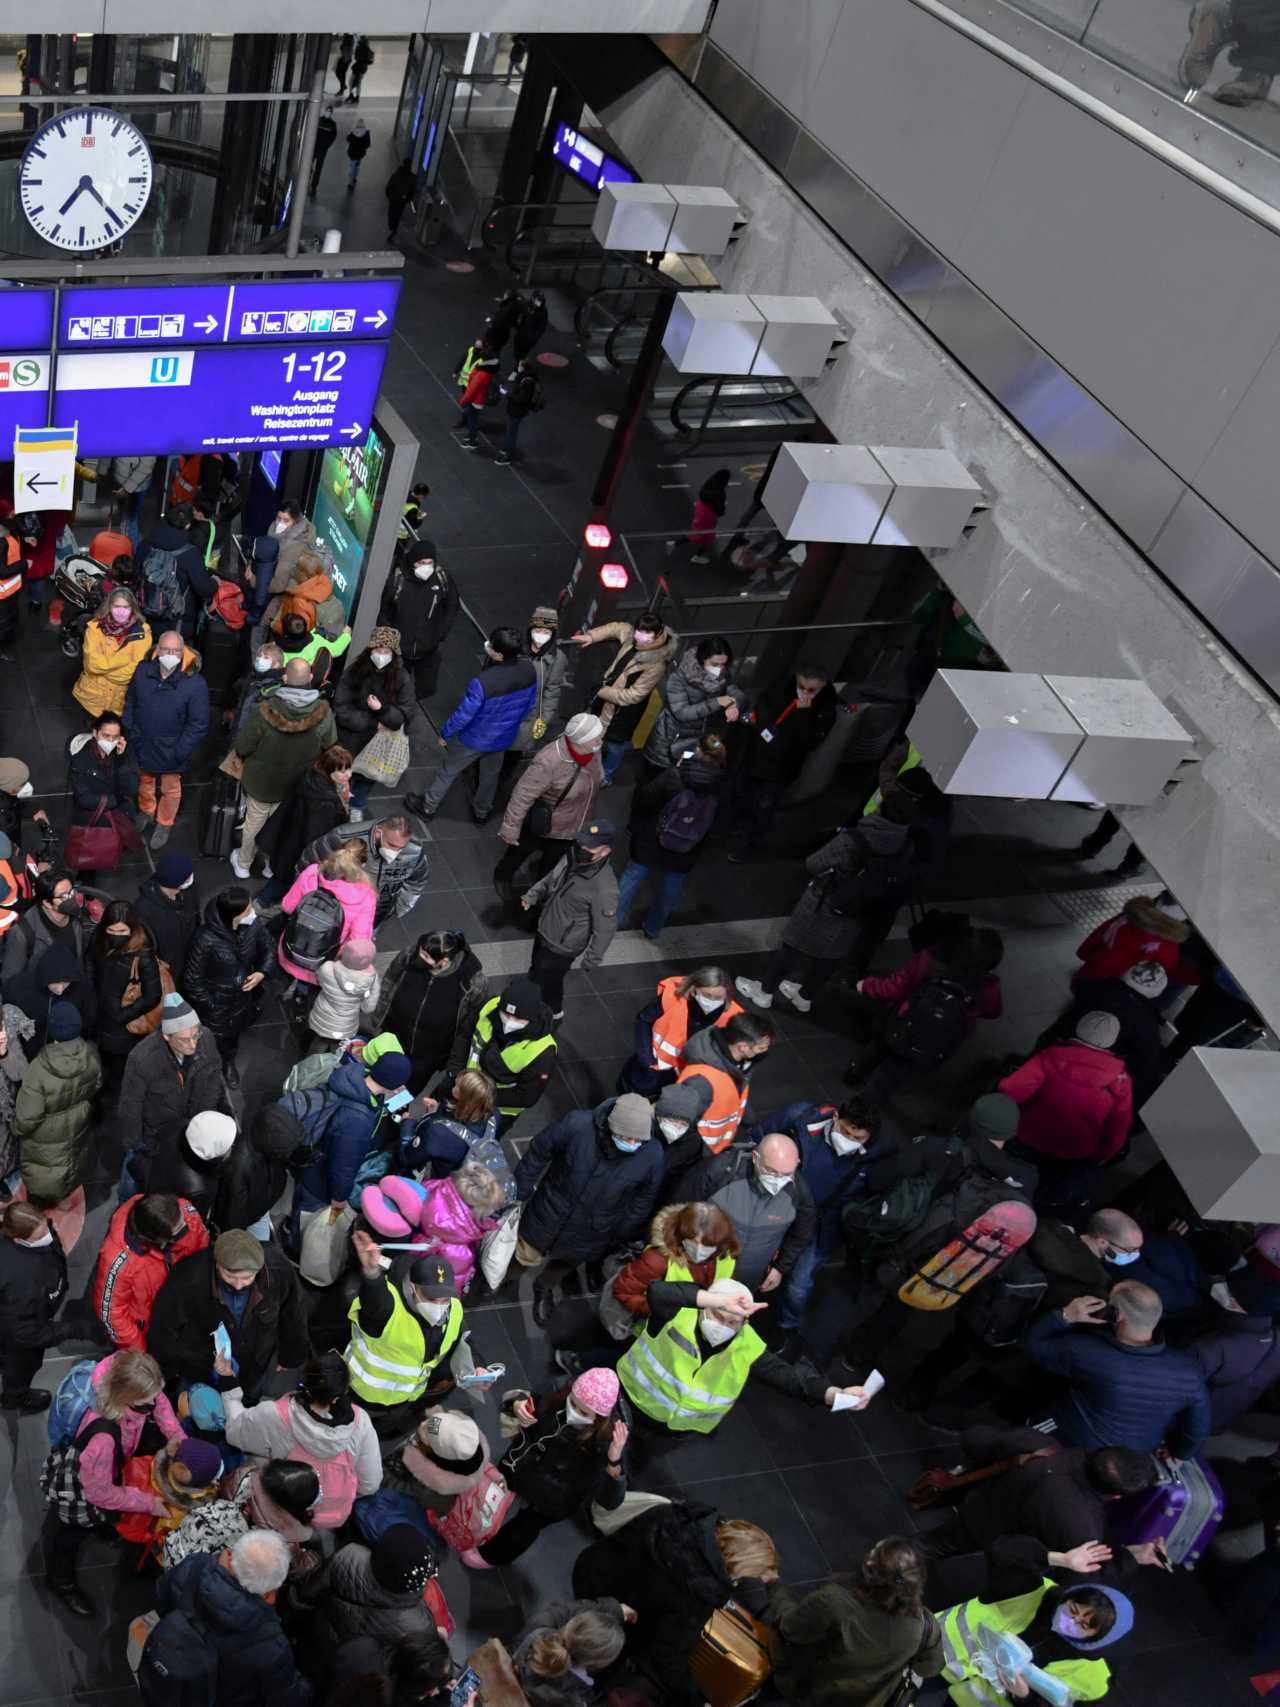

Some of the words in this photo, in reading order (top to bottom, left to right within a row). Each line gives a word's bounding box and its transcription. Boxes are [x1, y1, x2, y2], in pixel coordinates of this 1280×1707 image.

[266, 321, 281, 332] WC
[15, 360, 39, 386] S
[155, 358, 175, 382] U
[282, 350, 347, 383] 1-12
[293, 389, 340, 402] Ausgang
[250, 403, 337, 417] Washingtonplatz
[263, 417, 334, 430] Reisezentrum
